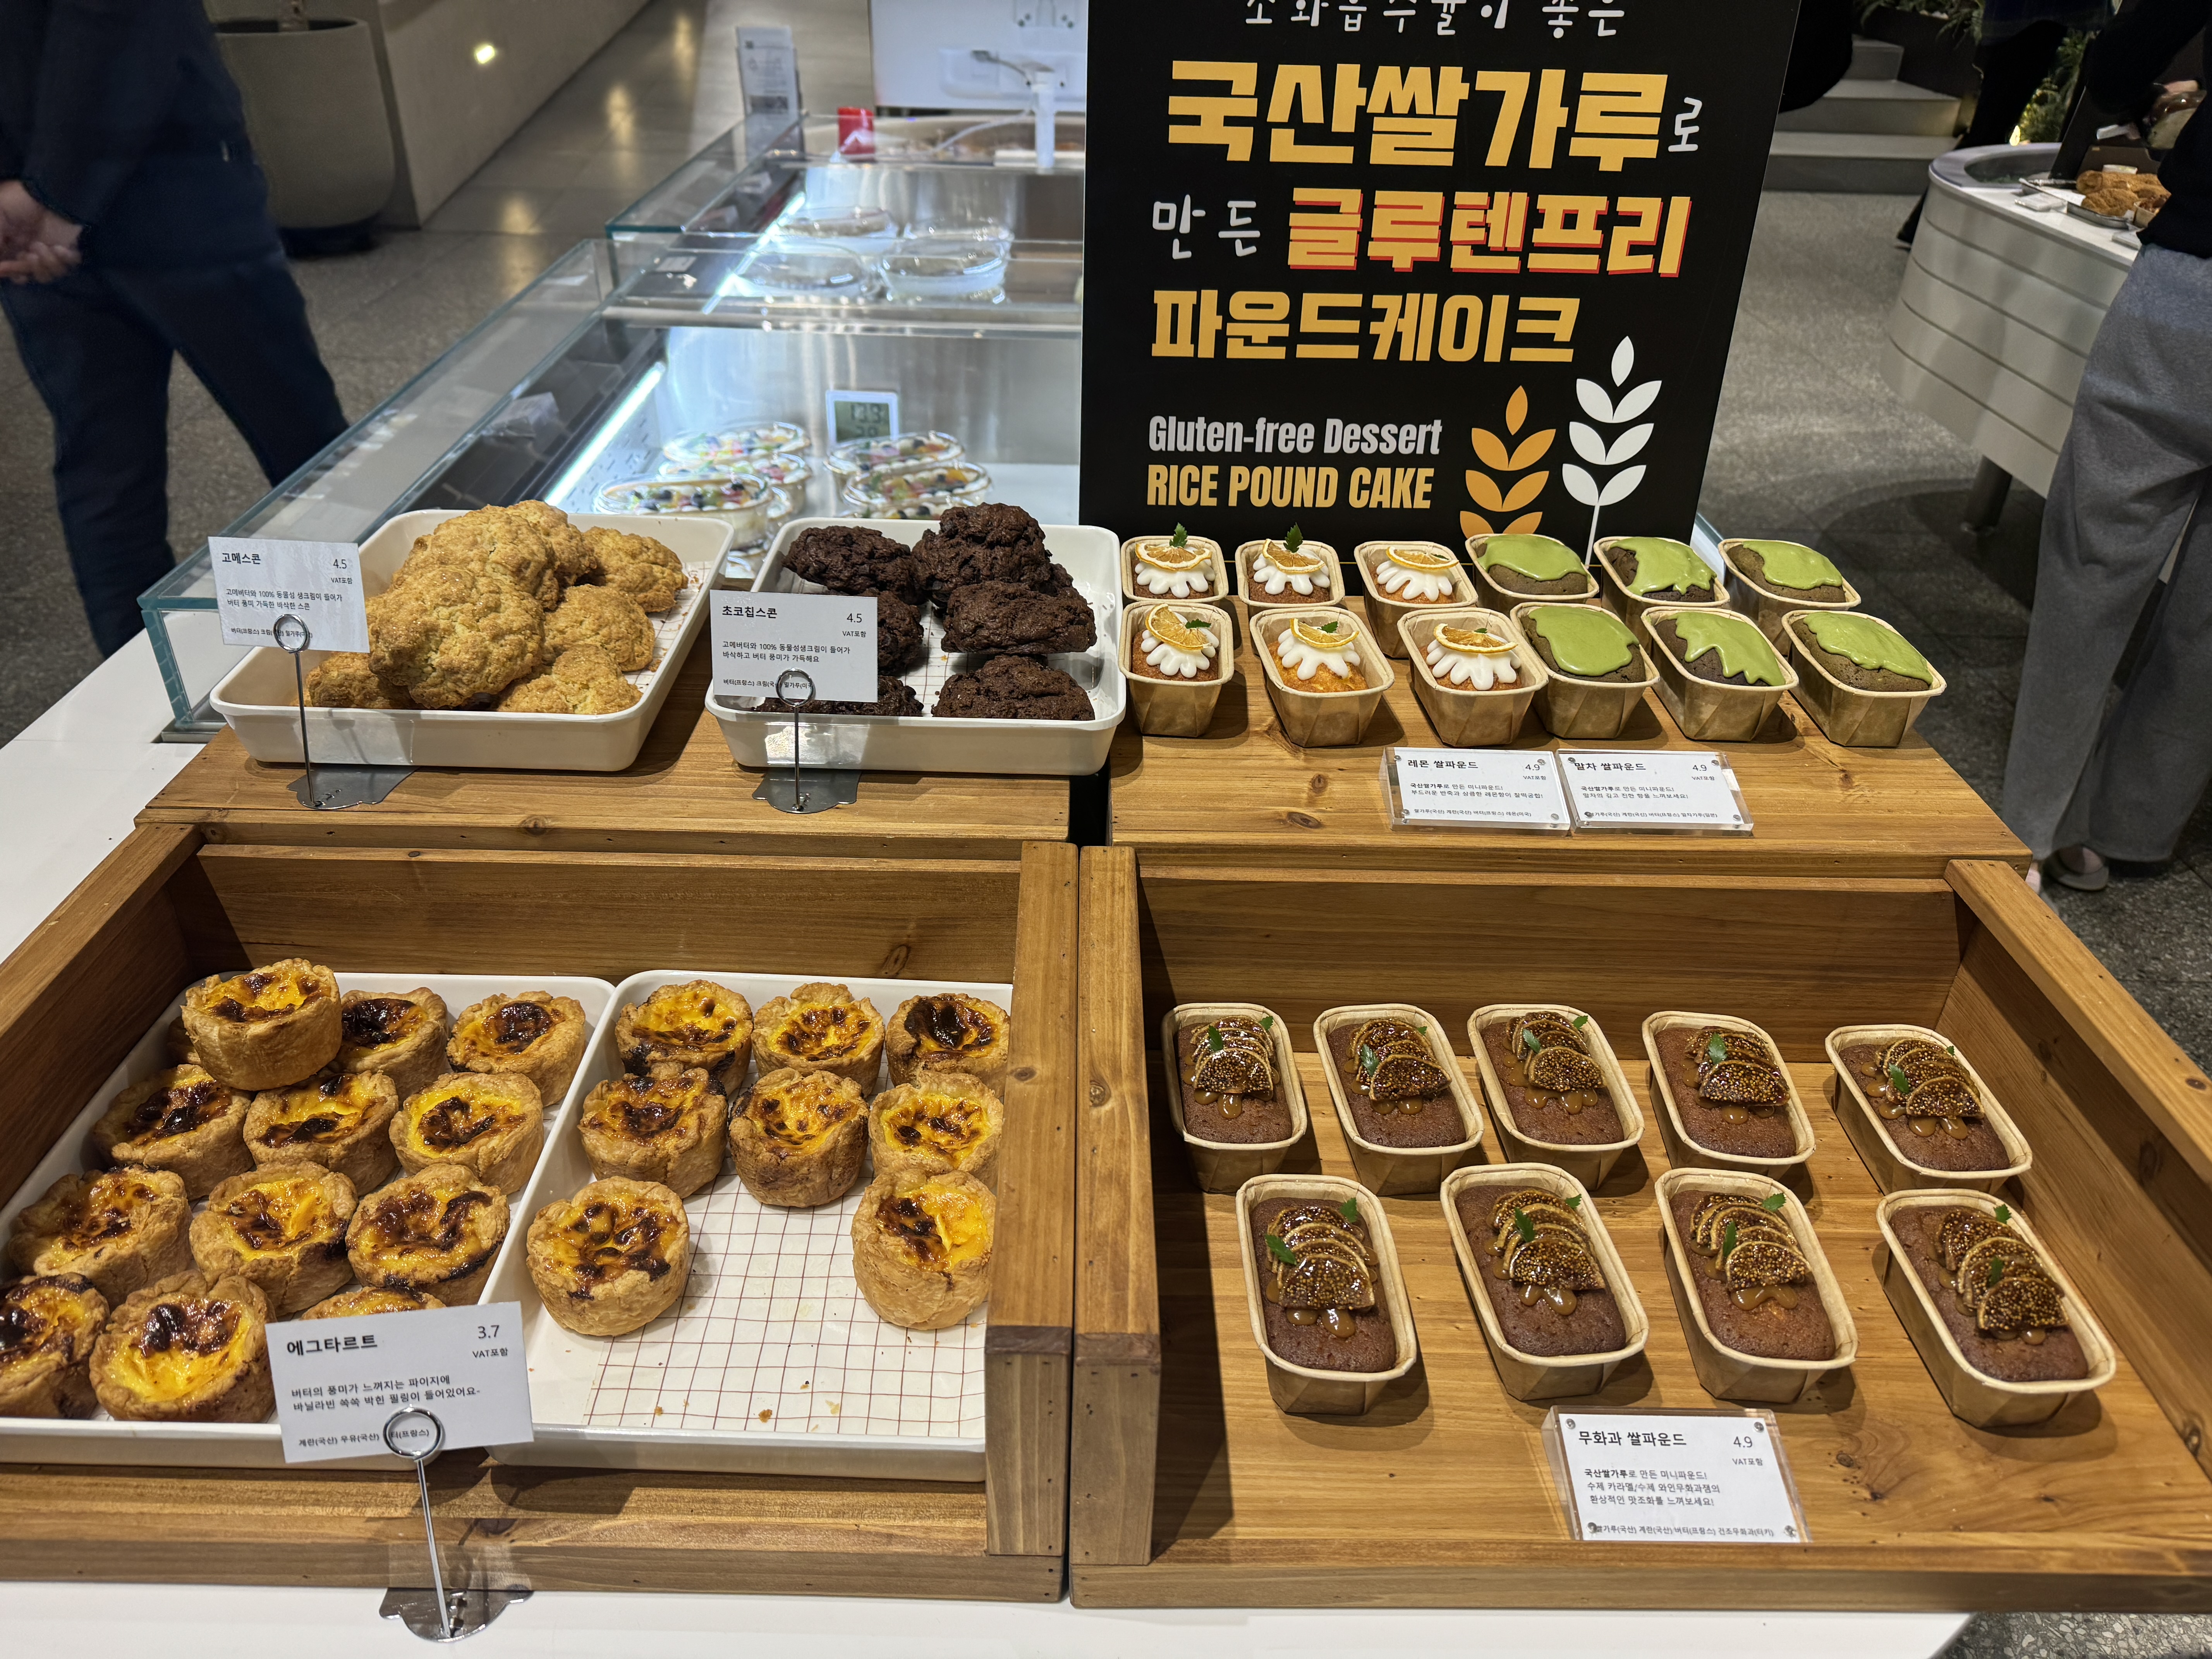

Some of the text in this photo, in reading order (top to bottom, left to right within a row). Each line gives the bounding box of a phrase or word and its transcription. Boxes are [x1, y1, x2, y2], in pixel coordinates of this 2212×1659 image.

[1542, 0, 1624, 38] 좋은
[1152, 188, 1692, 278] 만든 글루텐프리
[1151, 290, 1581, 363] 파운드케이크
[1149, 416, 1442, 456] Gluten-free Dessert
[1146, 464, 1435, 509] RICE POUND CAKE
[222, 553, 347, 569] 고메스콘 4.5
[226, 589, 256, 598] 고메버터와
[276, 591, 295, 599] 동물성
[297, 592, 322, 601] 생크림이
[323, 593, 342, 602] 들어가
[227, 599, 240, 607] 버터
[242, 599, 254, 608] 풍미
[276, 602, 295, 610] 바삭한
[722, 605, 862, 623] 초코칩스콘 4.5
[722, 641, 757, 650] 고메버터와
[830, 646, 850, 654] 들어가
[723, 651, 750, 659] 바삭하고
[769, 653, 790, 661] 풍미가
[792, 654, 819, 663] 가득해요
[1408, 760, 1429, 768] 레몬
[1433, 761, 1478, 769] 쌀파운드
[1574, 763, 1597, 771] 말차
[1601, 763, 1646, 771] 쌀파운드
[287, 1325, 500, 1356] 에그타르트 3.7
[472, 1347, 508, 1358] VAT포함
[291, 1387, 323, 1398] 버터의
[327, 1383, 358, 1396] 풍미가
[409, 1375, 450, 1388] 파이지에
[293, 1399, 335, 1412] 바닐라빈
[364, 1395, 385, 1406] 박힌
[389, 1391, 420, 1404] 필링이
[388, 1429, 429, 1439] 터(프랑스)
[1578, 1431, 1753, 1448] 무화과 쌀파운드 4.9
[1732, 1458, 1763, 1466] VAT포함
[1584, 1469, 1707, 1480] 국산쌀가루로 만든 미니파운드!
[1587, 1482, 1605, 1491] 수제
[1658, 1483, 1720, 1493] 와인무화과잼의
[1590, 1495, 1625, 1505] 환상적인
[1667, 1497, 1714, 1506] 느껴보세요!
